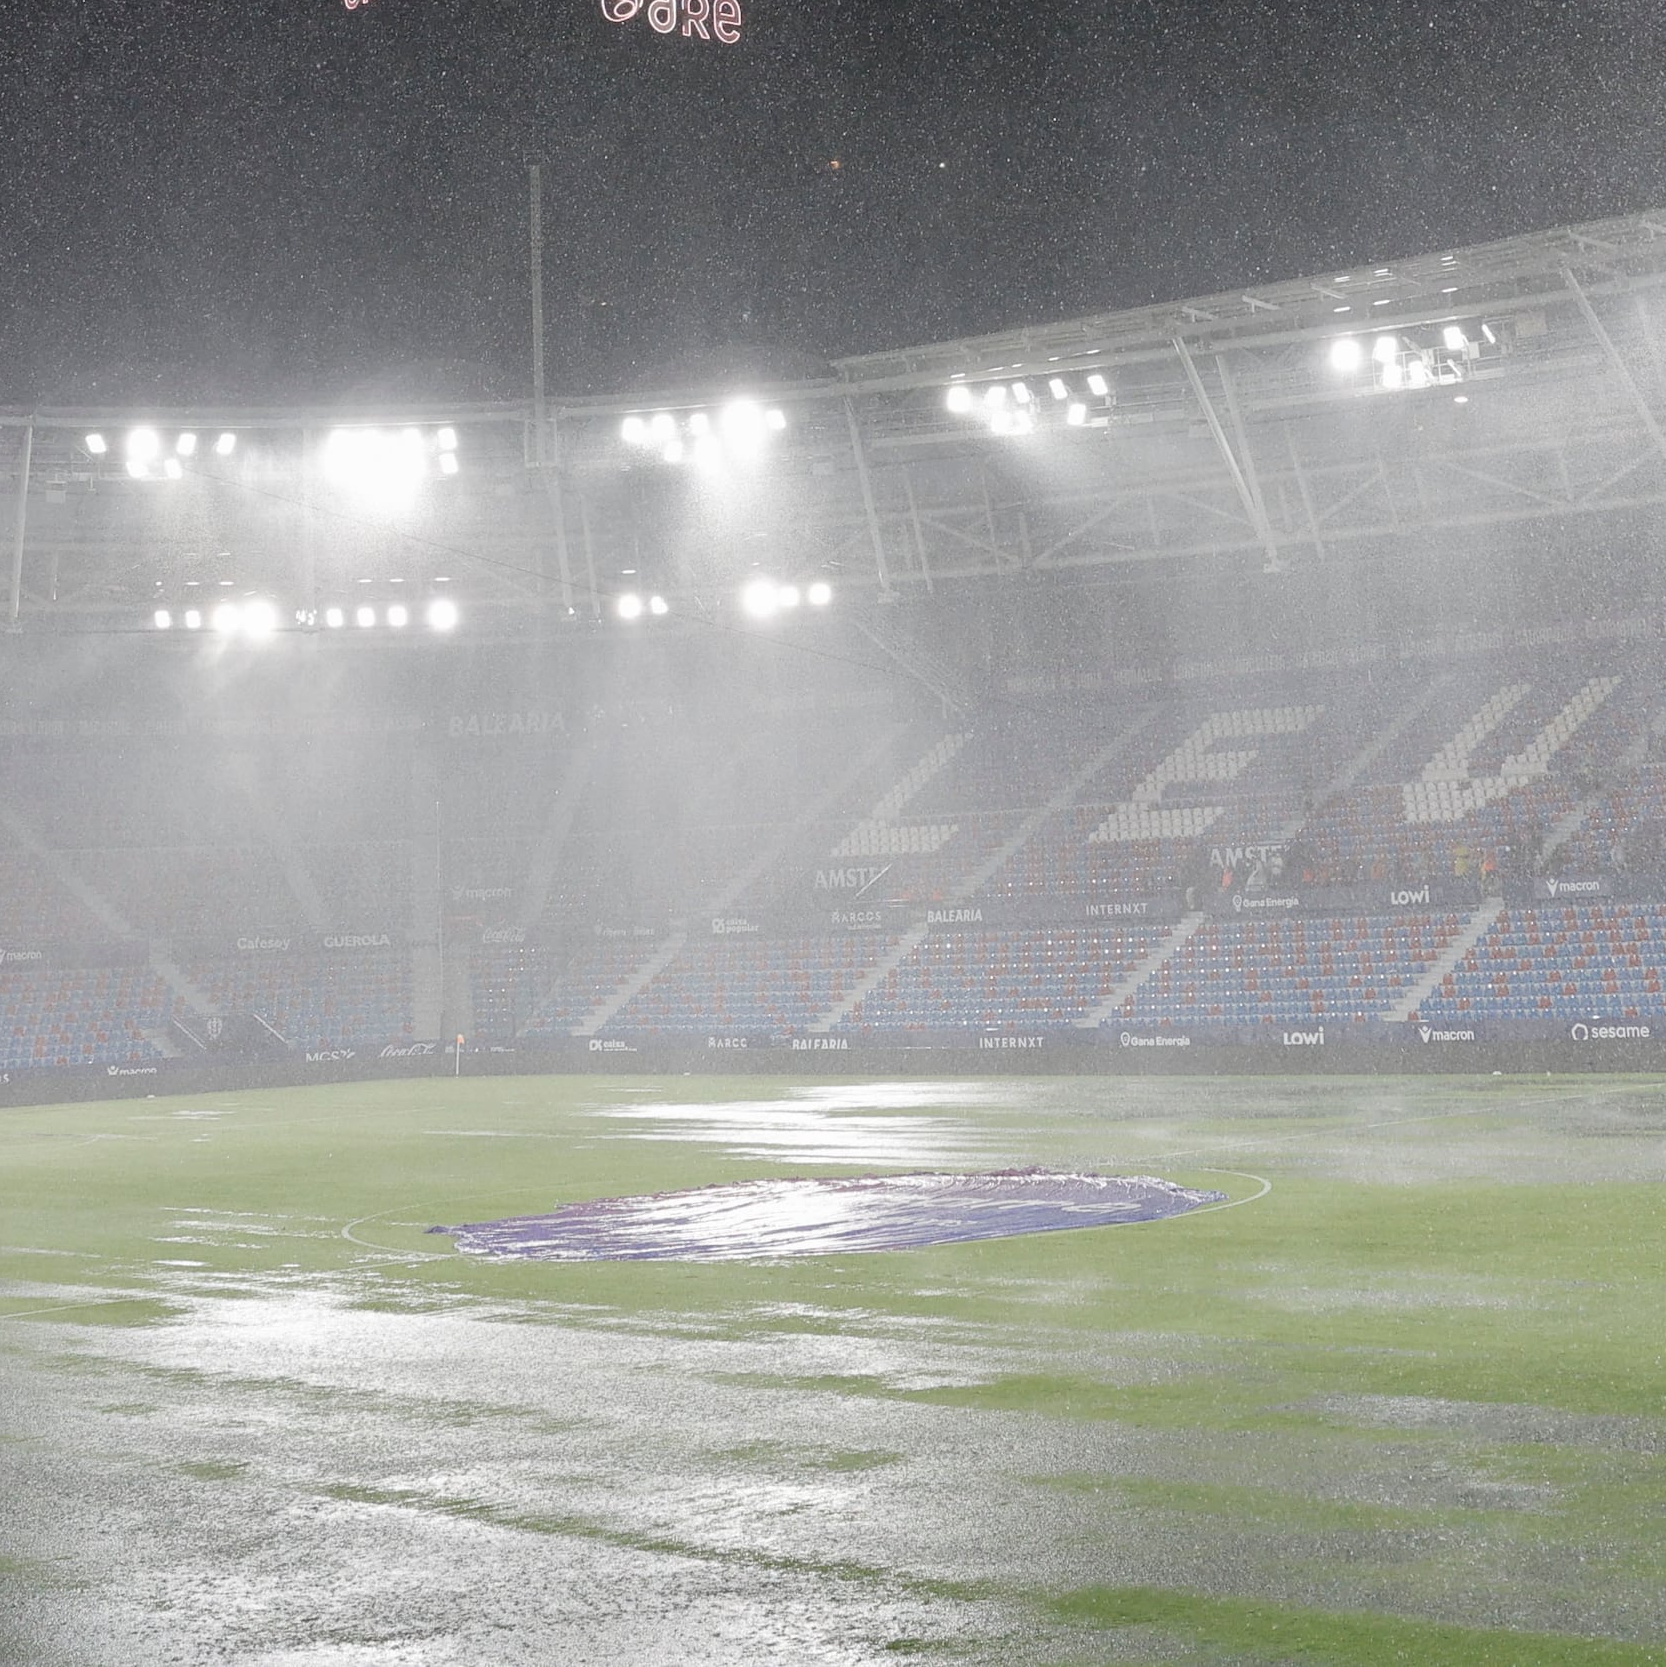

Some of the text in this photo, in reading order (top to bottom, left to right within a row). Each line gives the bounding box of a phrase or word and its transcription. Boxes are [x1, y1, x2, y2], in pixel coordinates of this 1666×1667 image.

[1559, 879, 1600, 891] macron
[1085, 902, 1149, 917] INTERNXT
[6, 949, 43, 962] macron
[1432, 1028, 1475, 1041] macron
[1591, 1023, 1651, 1039] sesame
[979, 1036, 1044, 1049] INTERNXT
